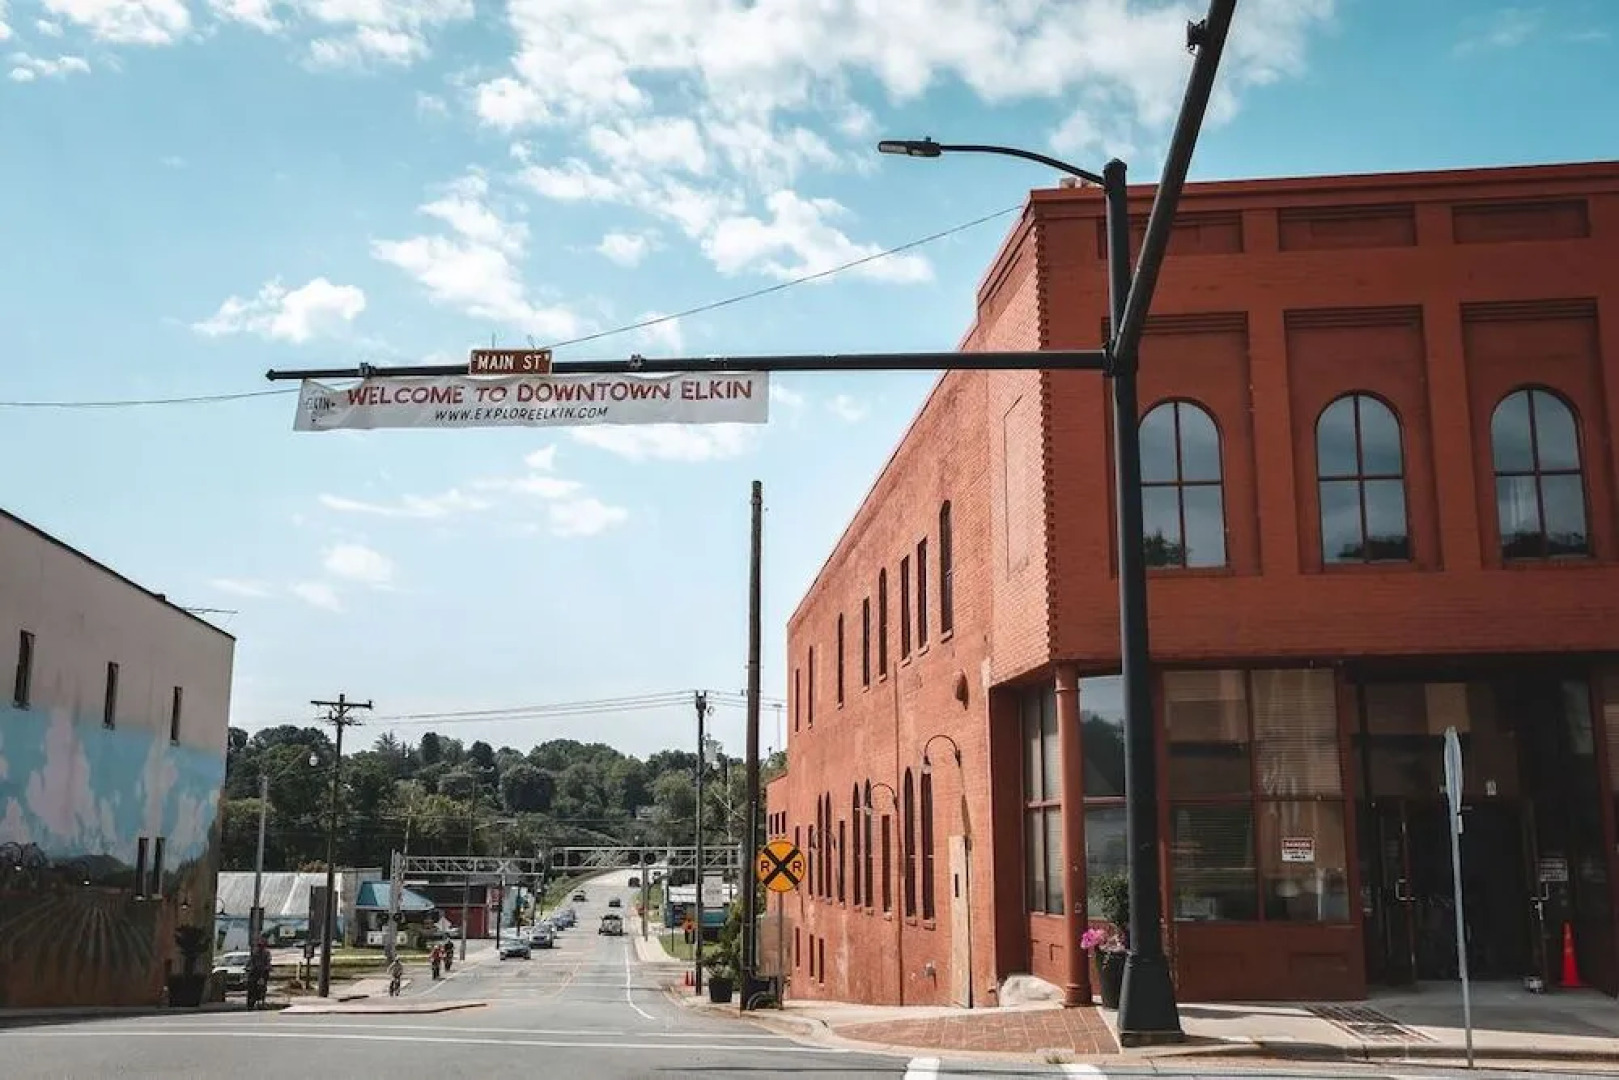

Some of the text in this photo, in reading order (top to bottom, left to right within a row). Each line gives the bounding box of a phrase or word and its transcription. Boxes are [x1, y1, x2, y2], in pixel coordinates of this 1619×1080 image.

[477, 355, 542, 370] MAIN ST
[347, 380, 752, 405] WELCOME TO DOWNTOWN ELKIN
[435, 407, 609, 421] WWW.EXPLOREELKIN.COM
[761, 860, 802, 872] R R
